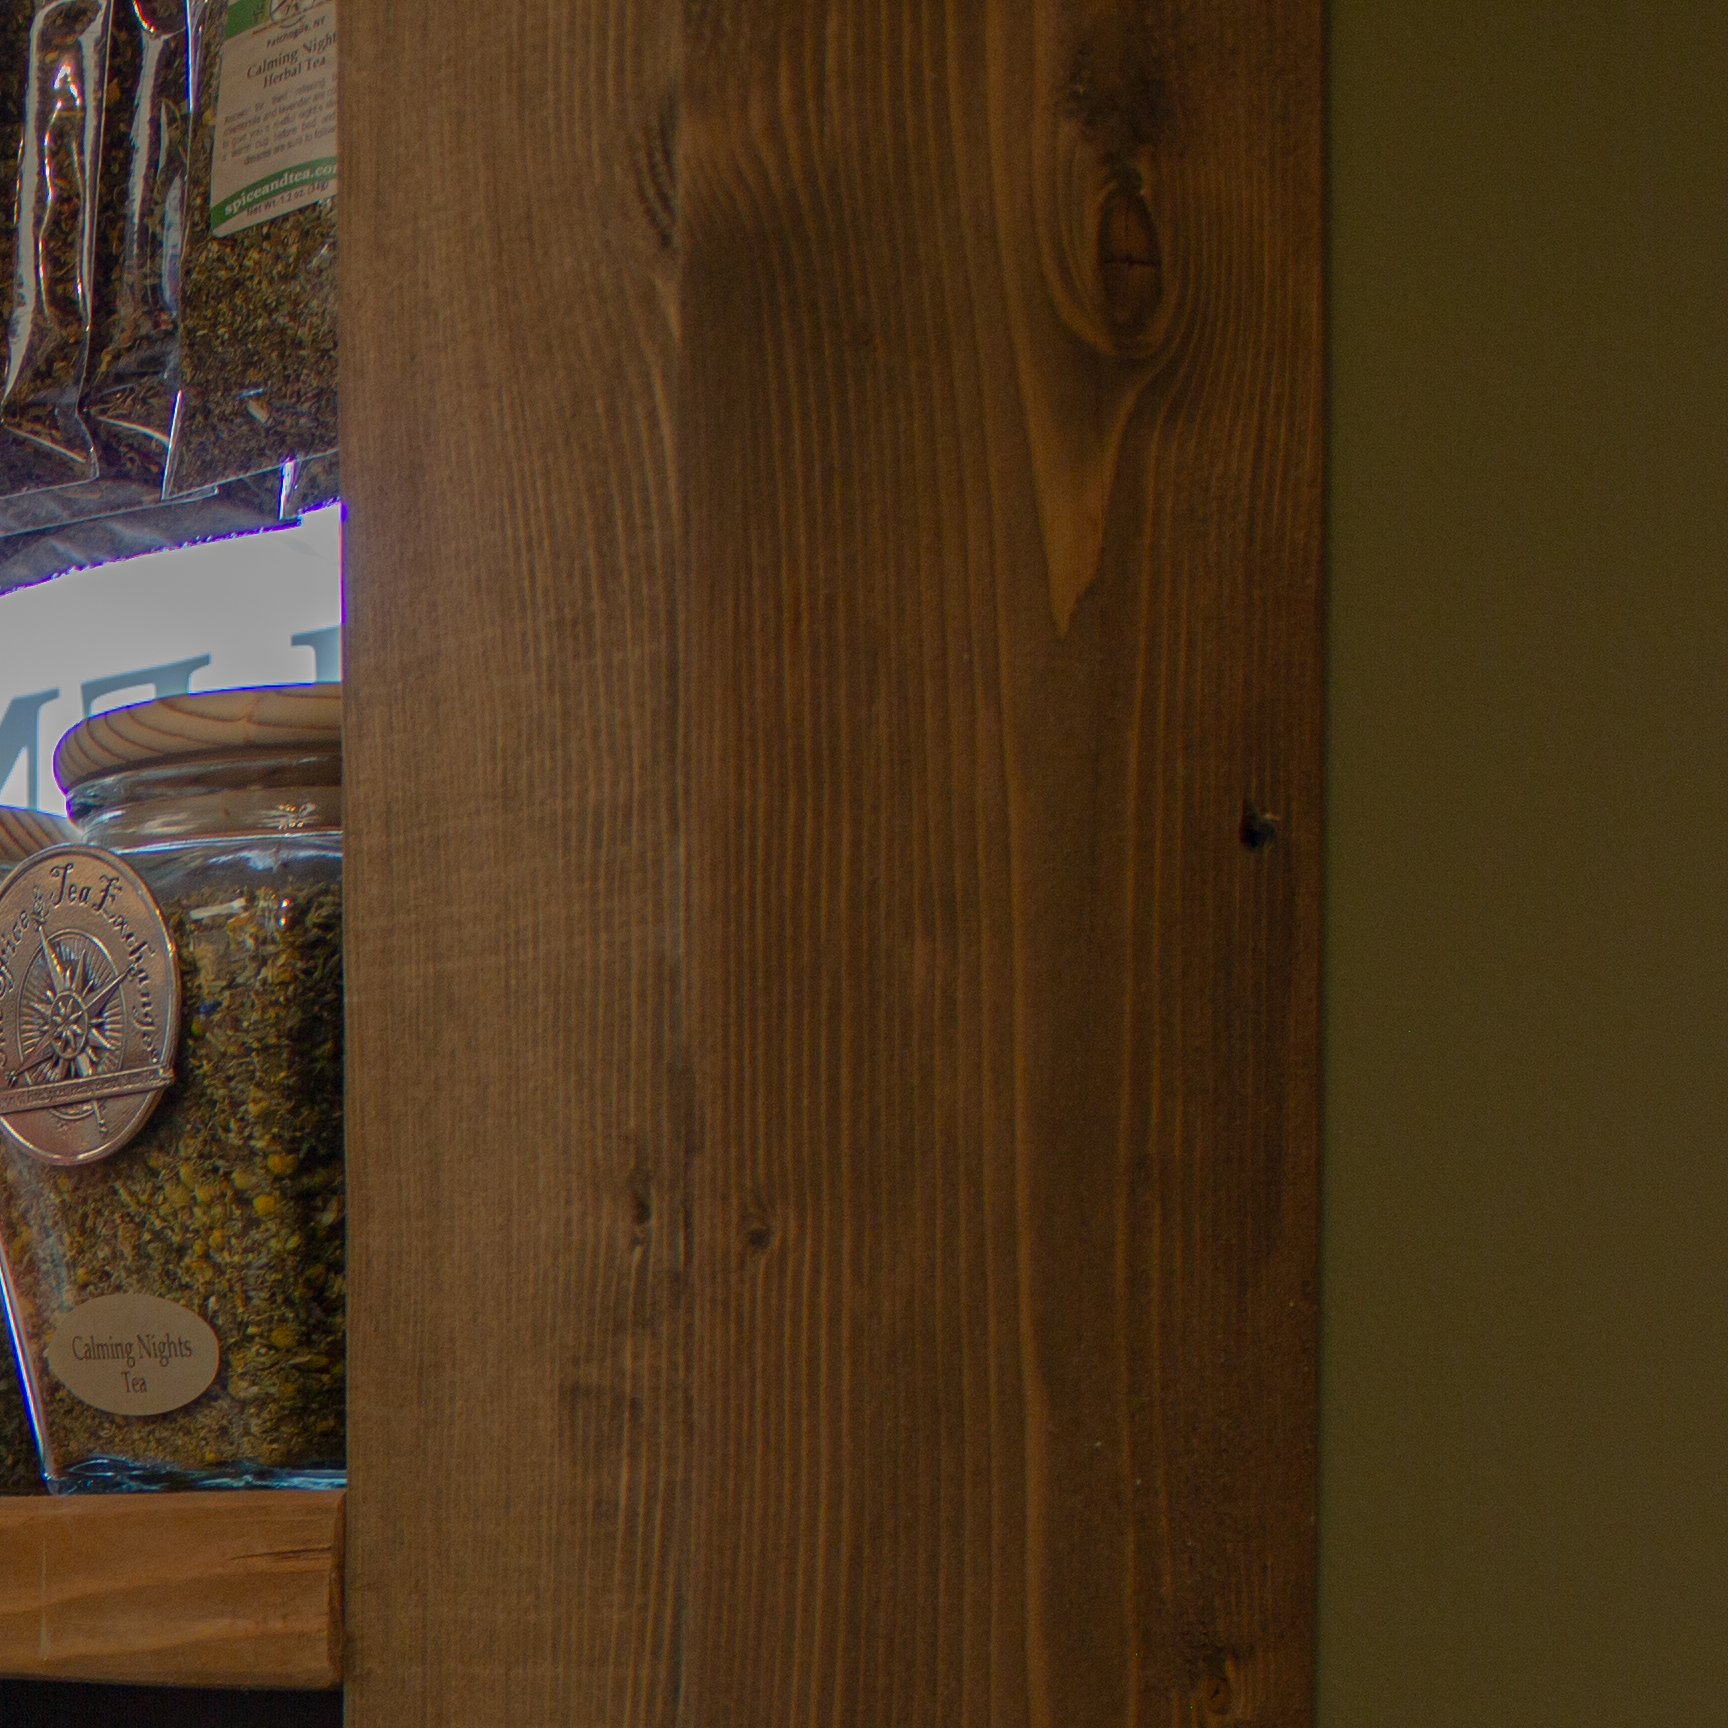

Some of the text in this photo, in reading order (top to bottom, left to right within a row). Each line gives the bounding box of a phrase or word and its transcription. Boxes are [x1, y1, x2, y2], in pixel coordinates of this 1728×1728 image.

[247, 32, 338, 79] Calming Night
[263, 56, 326, 88] Herbal Tea
[50, 862, 91, 908] Tea
[93, 874, 160, 1064] Exchange
[72, 1333, 193, 1368] Calming Nights
[121, 1371, 148, 1394] Tea
